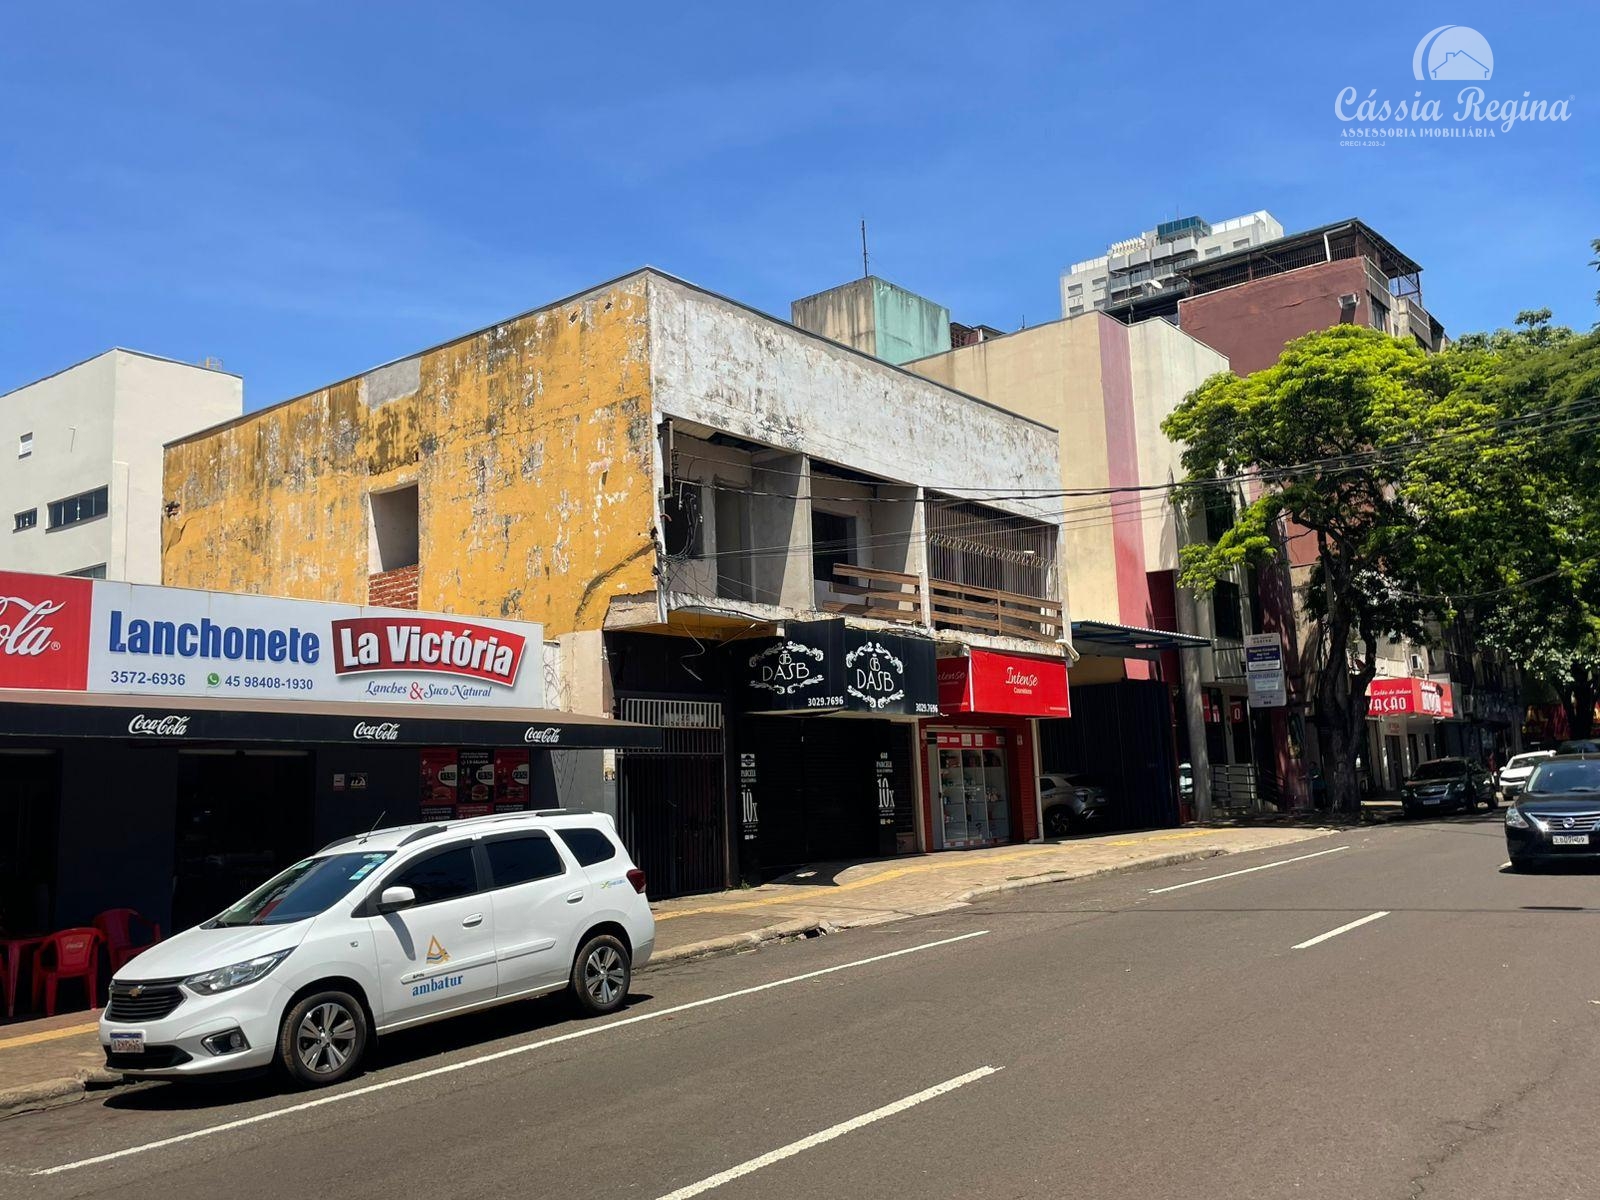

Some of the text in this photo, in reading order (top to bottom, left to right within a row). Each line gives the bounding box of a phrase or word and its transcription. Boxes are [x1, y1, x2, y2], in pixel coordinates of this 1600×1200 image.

[109, 610, 320, 664] Lanchonete
[340, 625, 514, 677] La Victória
[110, 670, 186, 686] 3572-6936
[762, 662, 810, 682] DASB
[856, 668, 895, 692] DASB
[1005, 666, 1038, 687] Intense
[225, 675, 314, 690] 45 98408-1930
[365, 680, 493, 700] Lanches & Suco Natural
[807, 696, 844, 707] 3029.7696
[412, 976, 464, 996] ambatur
